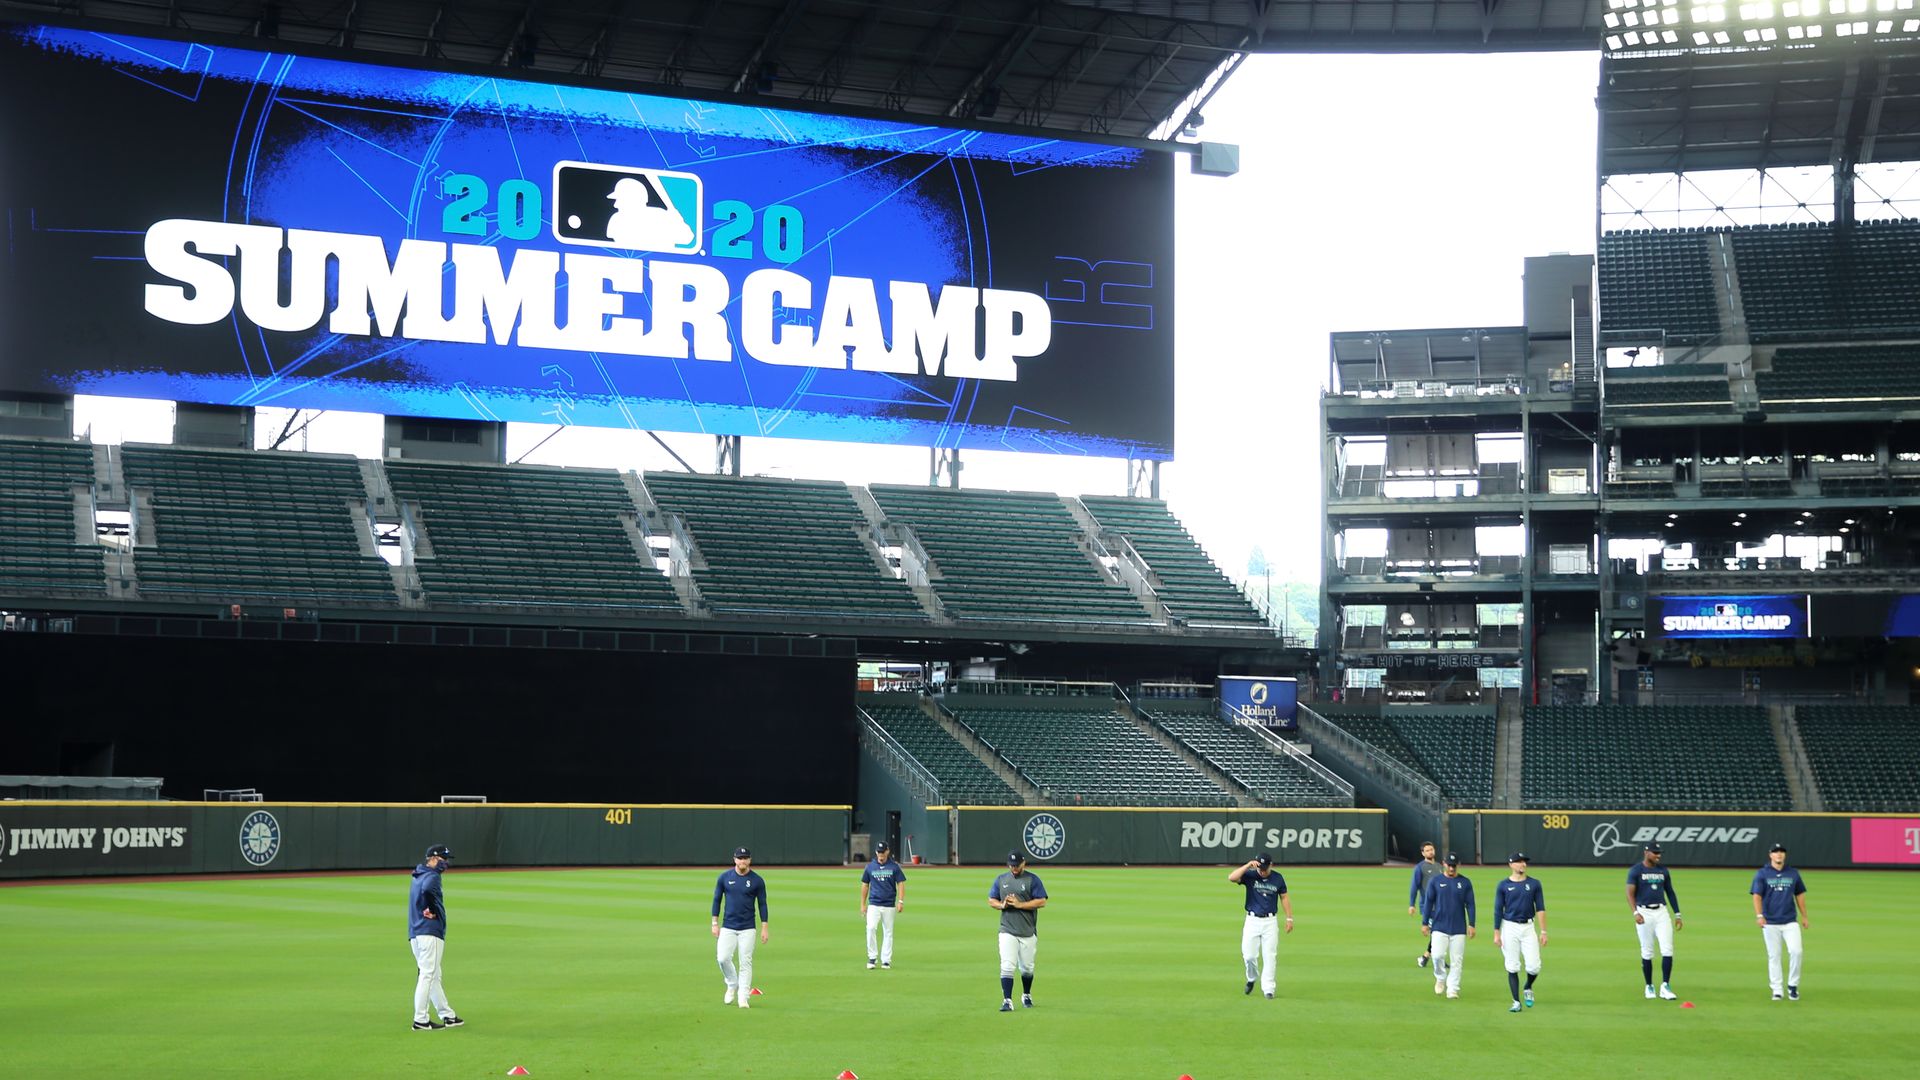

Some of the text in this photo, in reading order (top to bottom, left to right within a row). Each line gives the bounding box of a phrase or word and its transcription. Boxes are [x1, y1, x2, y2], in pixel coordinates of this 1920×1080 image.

[442, 173, 804, 264] 20 20
[144, 218, 1052, 382] SUMMER CAMP
[1663, 615, 1791, 631] SUMMER CAMP
[1241, 704, 1276, 716] Holland
[605, 808, 632, 825] 401
[1542, 814, 1570, 829] 380
[9, 827, 185, 856] JIMMY JOHN'S
[1180, 821, 1363, 849] ROOT SPORTS
[1631, 826, 1760, 843] BOEING
